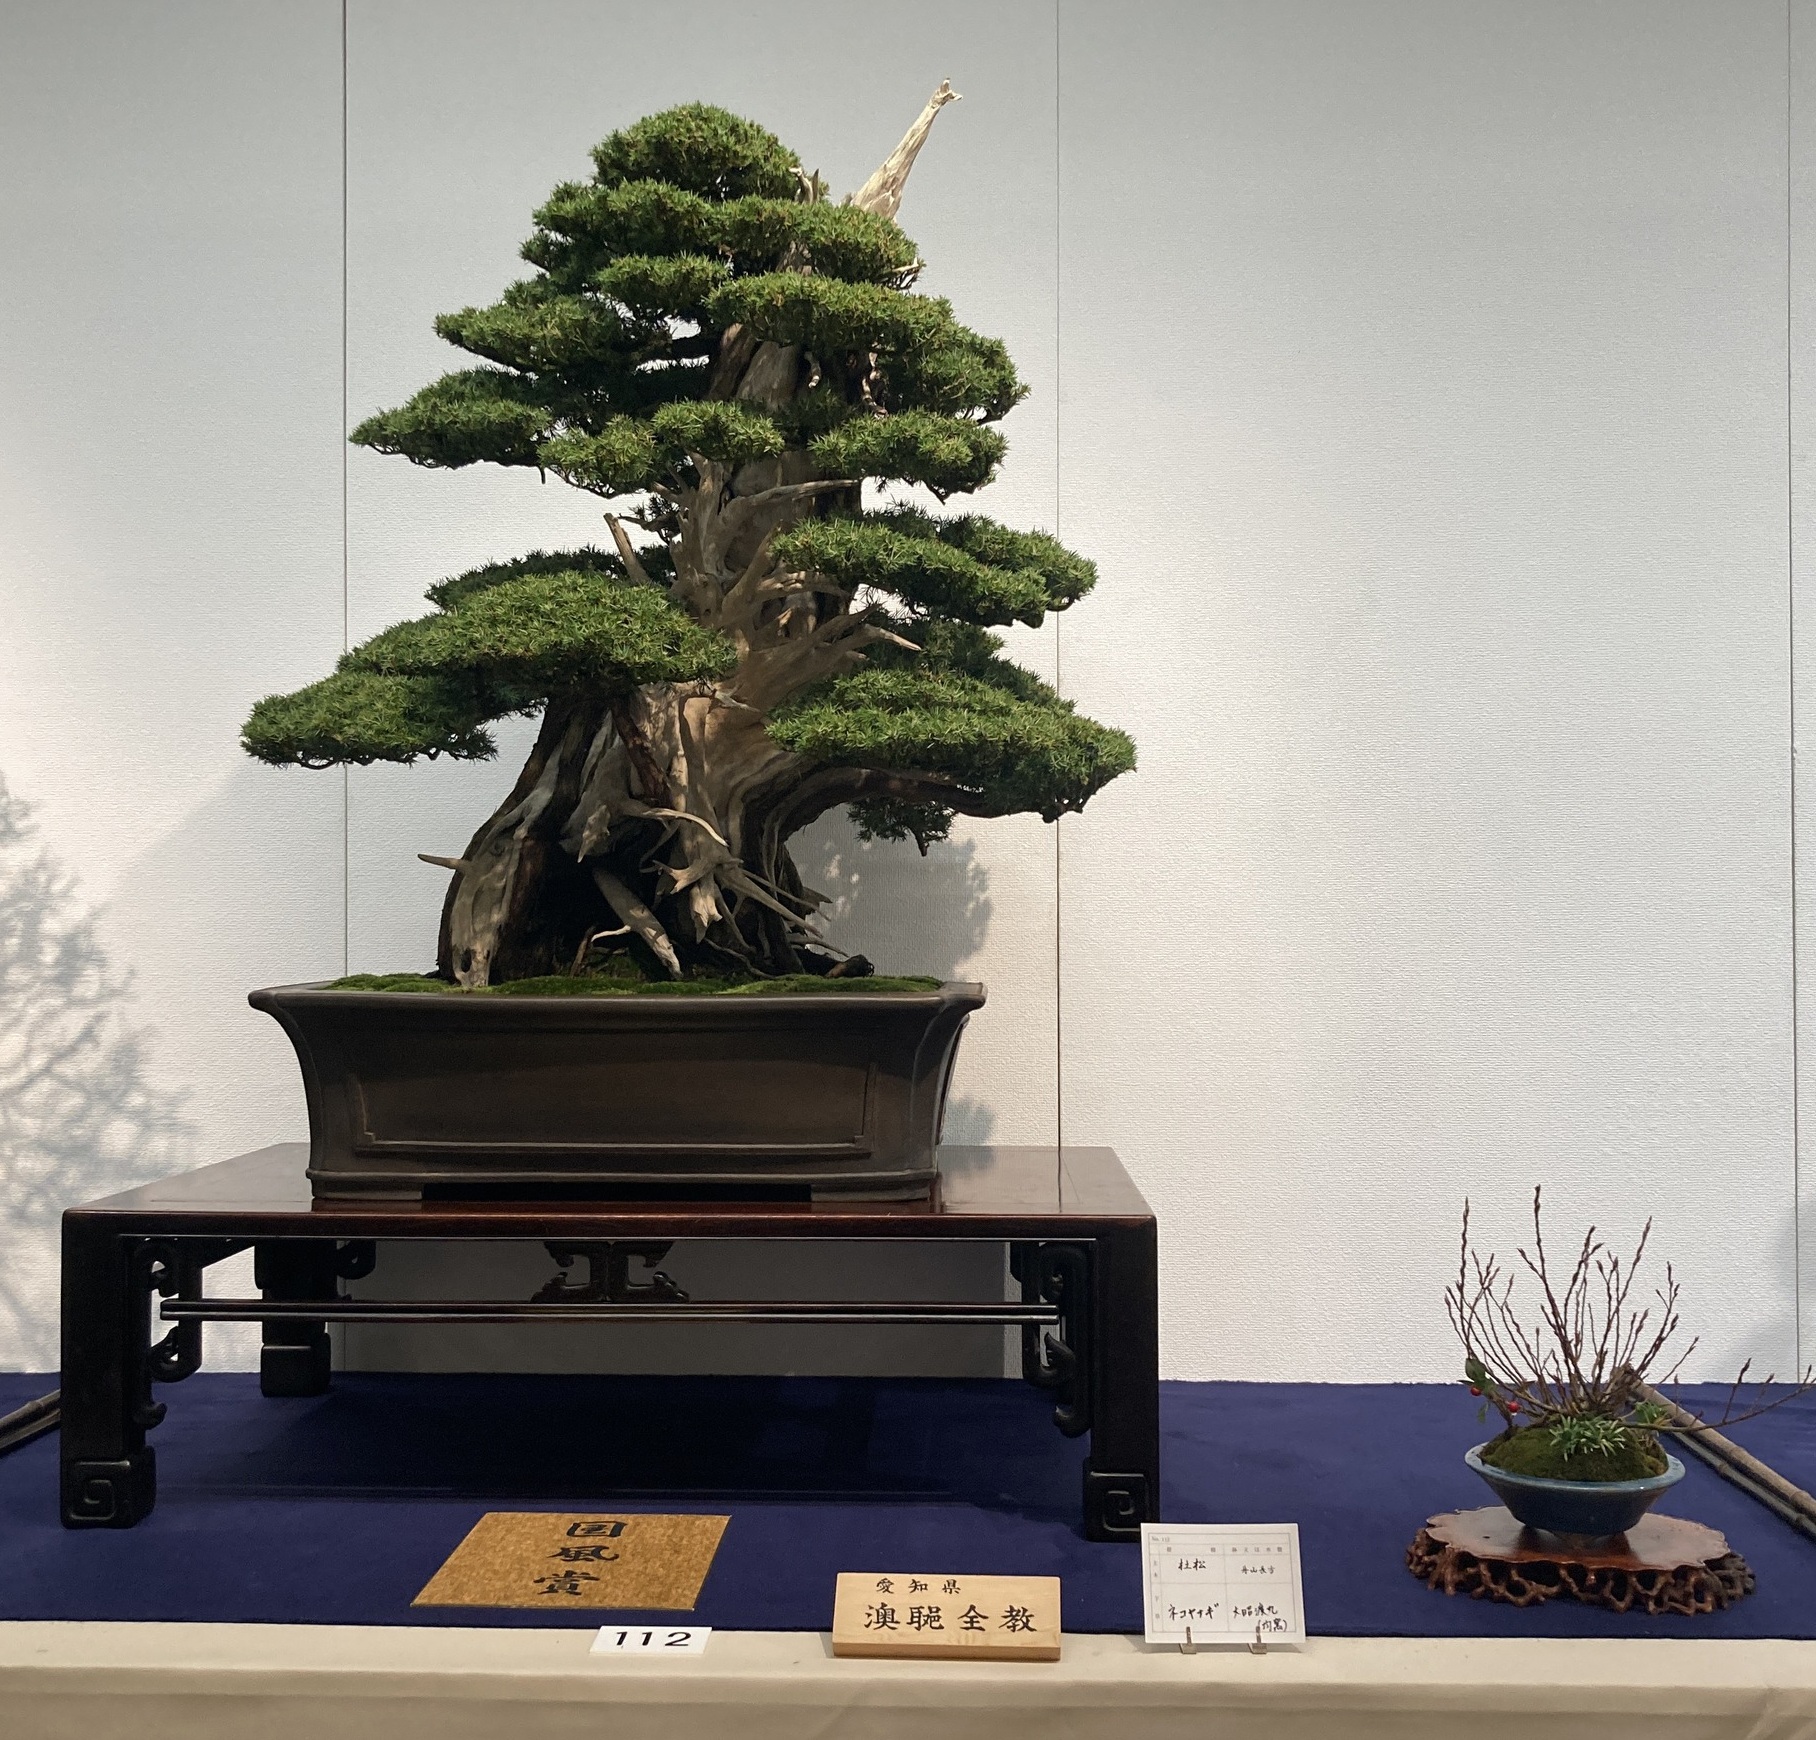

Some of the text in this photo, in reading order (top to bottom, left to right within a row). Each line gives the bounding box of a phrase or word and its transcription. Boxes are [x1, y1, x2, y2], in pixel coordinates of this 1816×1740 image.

[1178, 1558, 1206, 1571] 杜松
[876, 1577, 961, 1595] 愛知県
[1168, 1603, 1219, 1621] ネコヤナギ
[615, 1631, 692, 1648] 112
